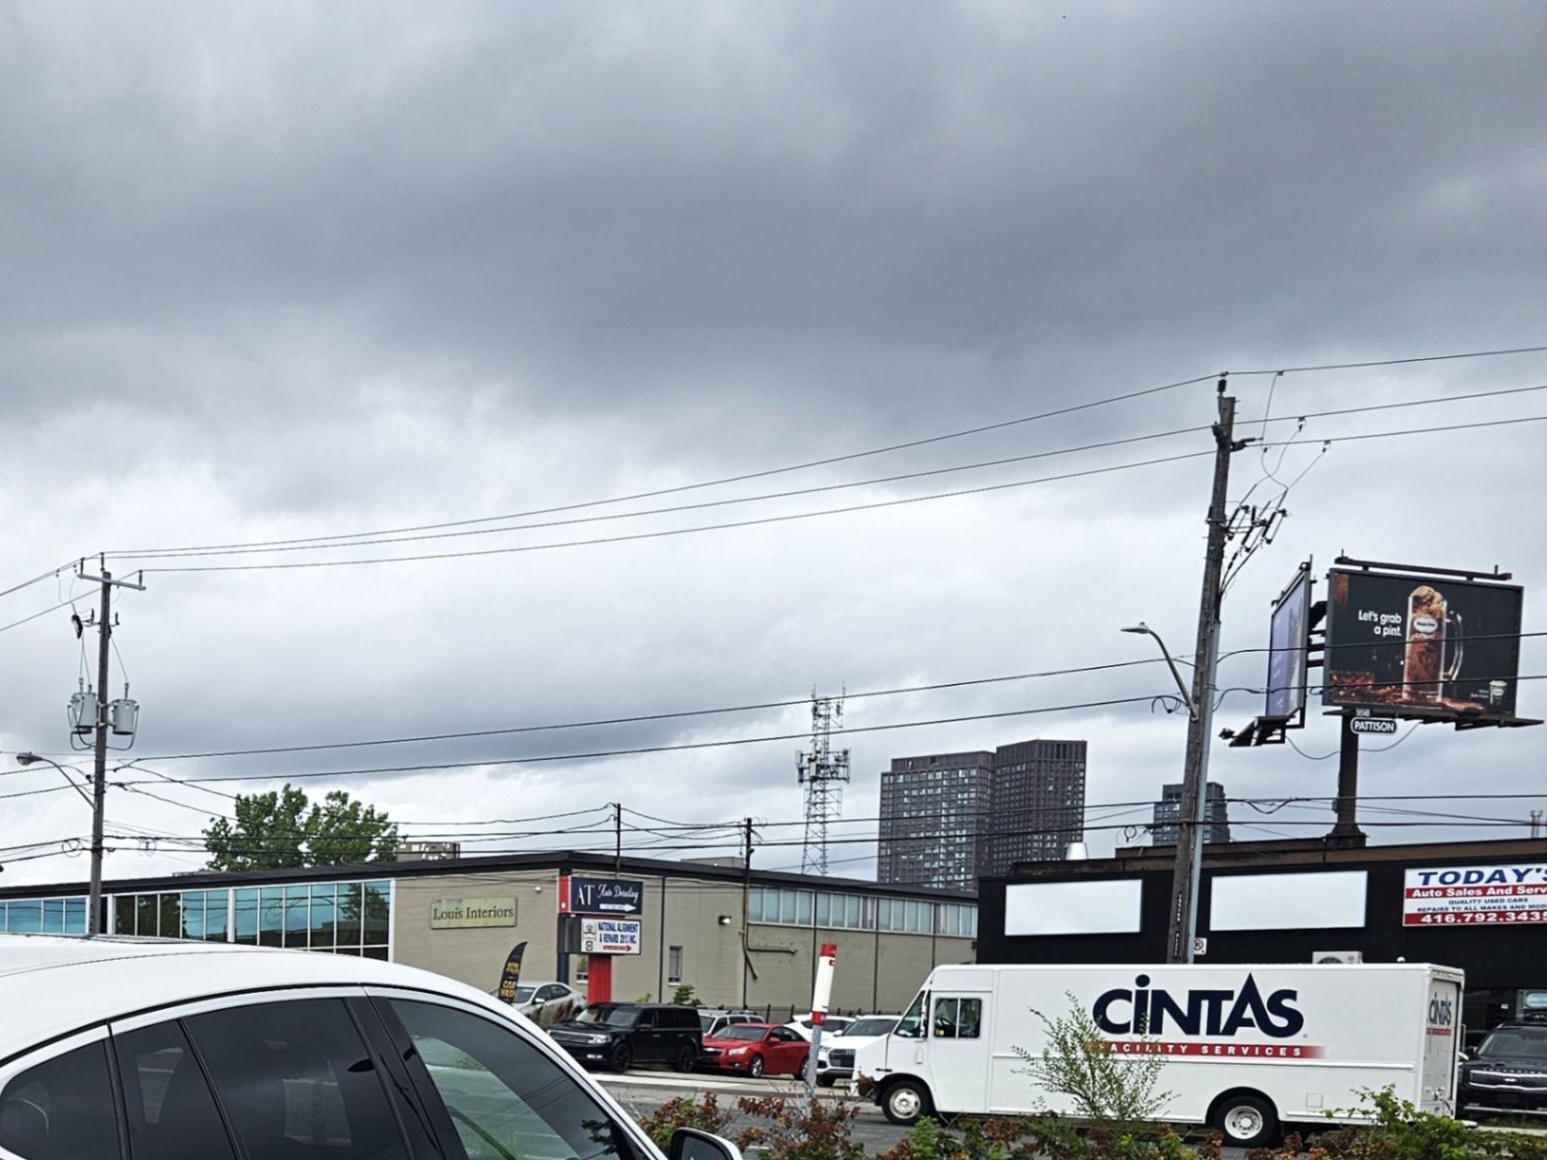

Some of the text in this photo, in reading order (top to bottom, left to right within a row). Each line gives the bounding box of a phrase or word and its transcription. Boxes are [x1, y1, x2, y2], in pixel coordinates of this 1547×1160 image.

[1358, 609, 1378, 622] Let's
[1380, 613, 1402, 625] grab
[1374, 625, 1402, 637] a pint.
[1354, 720, 1395, 732] PATTISON
[575, 884, 595, 906] AT
[1412, 888, 1443, 898] Auto
[1446, 887, 1483, 897] Sales
[1486, 886, 1512, 896] And
[433, 905, 514, 920] Louis Interiors
[1093, 972, 1304, 1038] CINTAS
[1201, 1044, 1302, 1056] SERVICES
